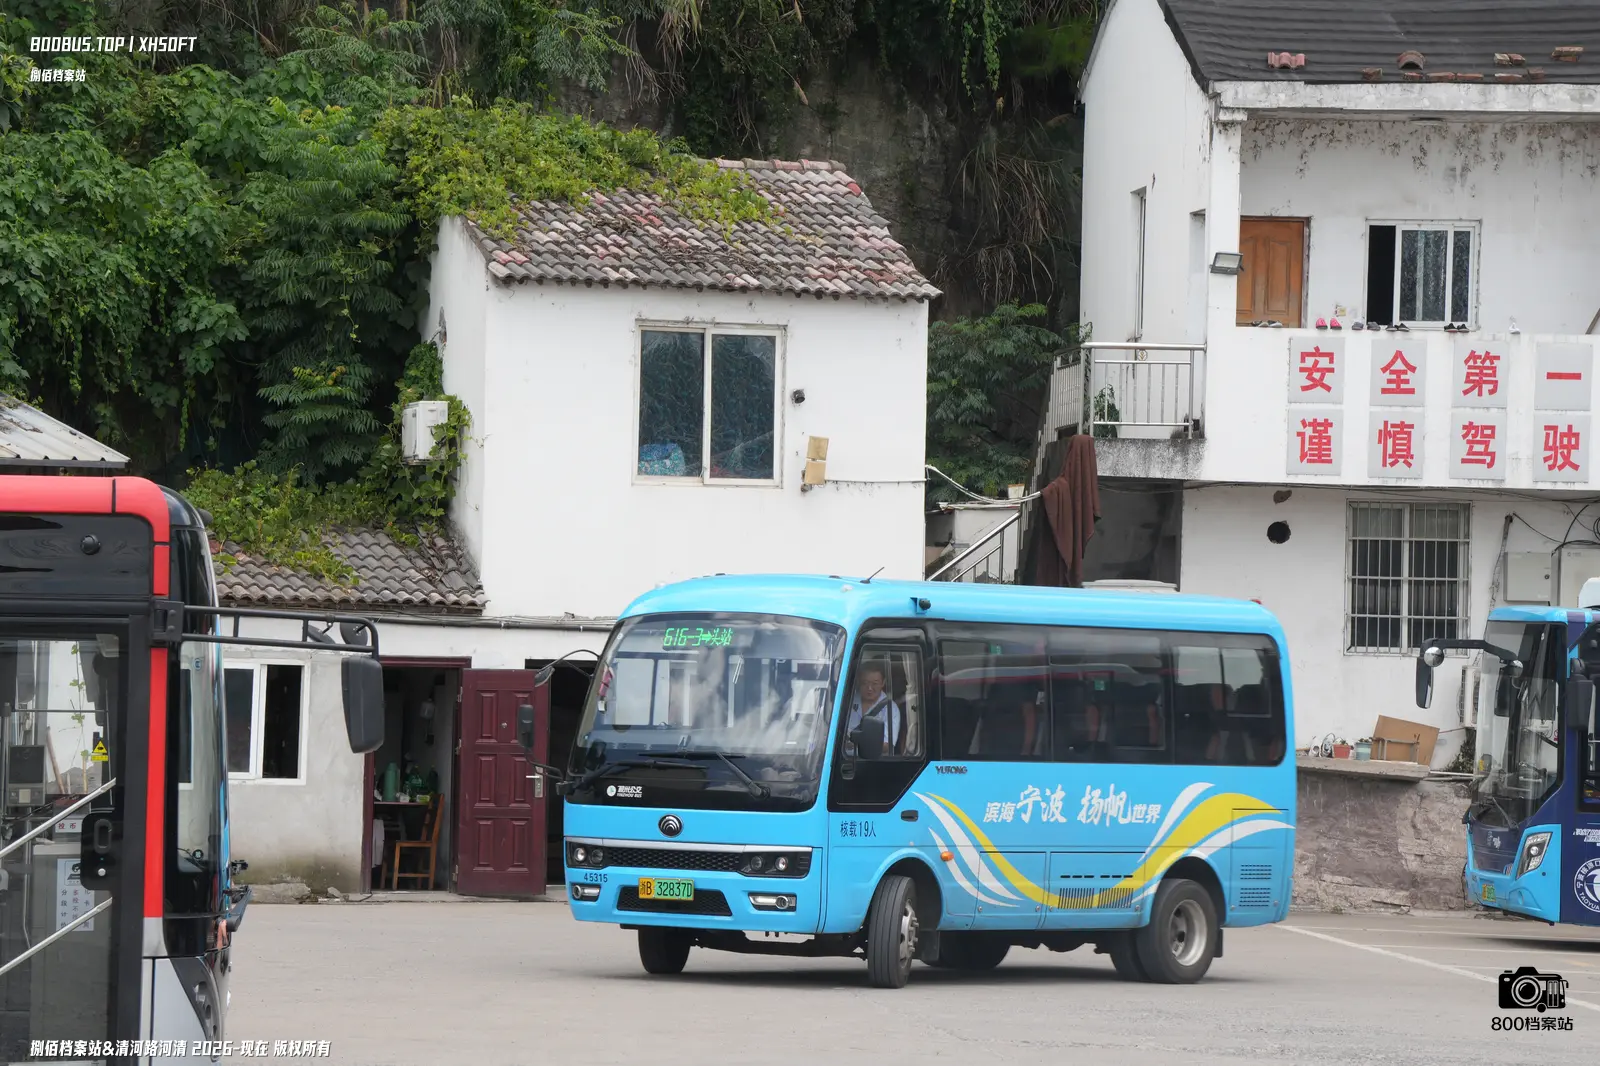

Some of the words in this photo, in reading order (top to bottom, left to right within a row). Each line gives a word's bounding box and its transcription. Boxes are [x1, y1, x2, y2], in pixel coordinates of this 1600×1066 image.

[1299, 345, 1582, 397] 安全第一
[1296, 417, 1581, 472] 谨慎驾驶
[663, 627, 704, 647] 616-3
[935, 765, 968, 775] YUTONG
[983, 784, 1067, 824] 滨海宁波
[1077, 783, 1161, 827] 扬帆世界
[840, 820, 876, 838] 核载19人
[583, 872, 608, 883] 45315
